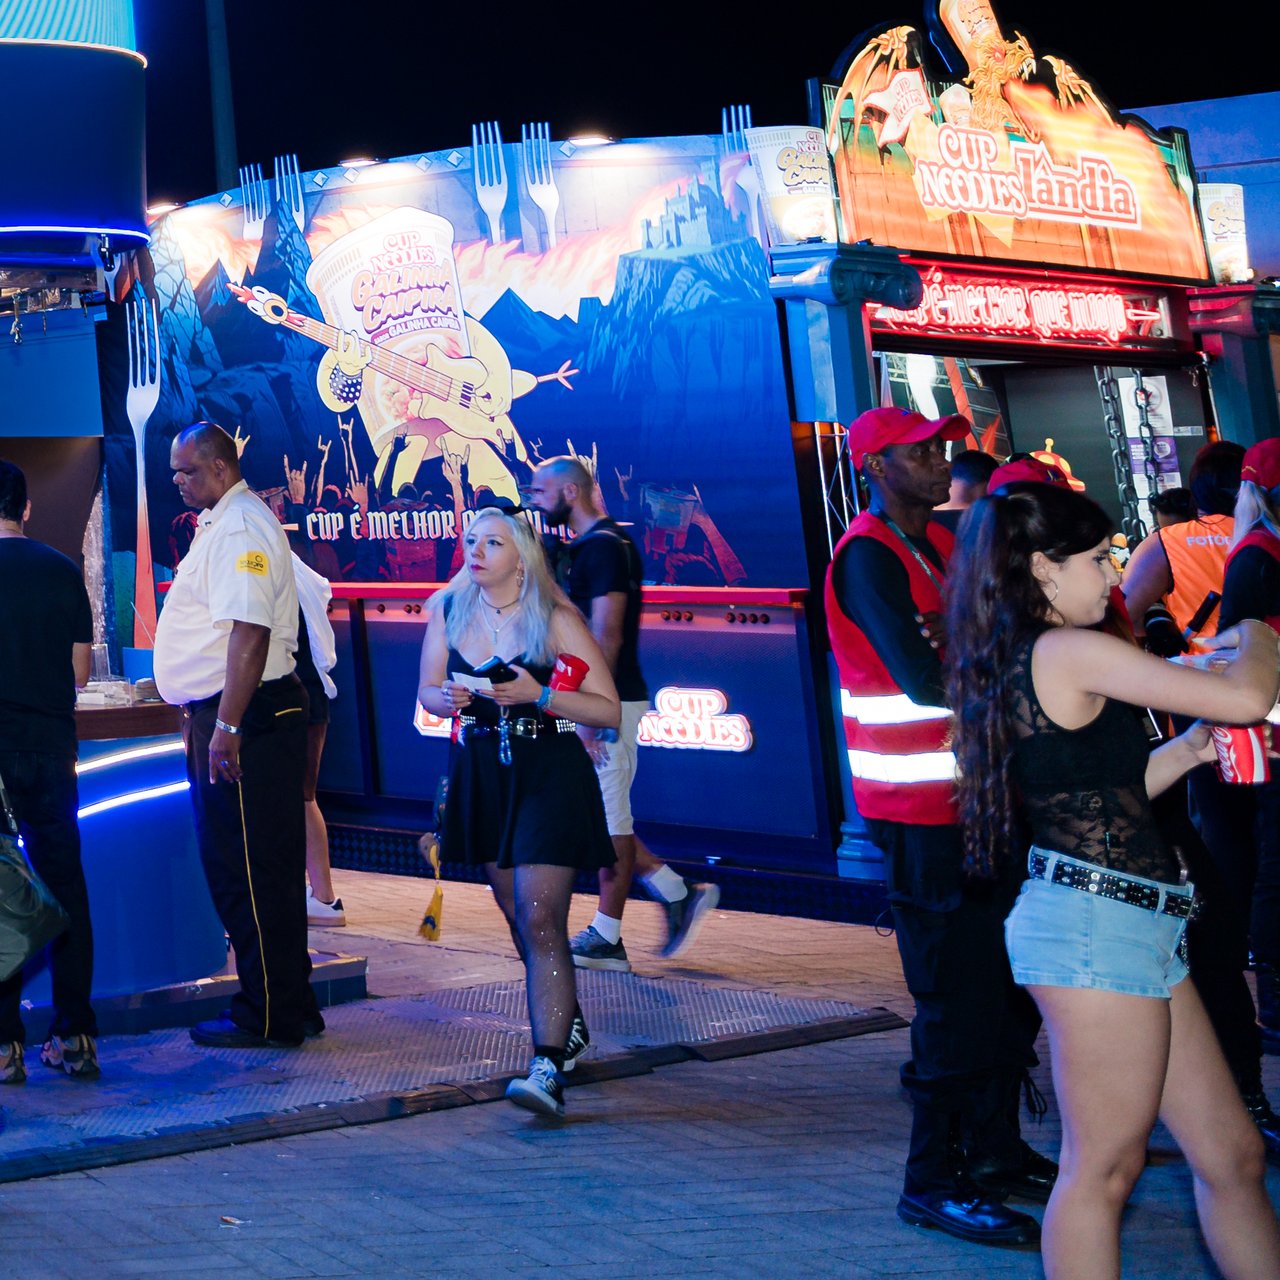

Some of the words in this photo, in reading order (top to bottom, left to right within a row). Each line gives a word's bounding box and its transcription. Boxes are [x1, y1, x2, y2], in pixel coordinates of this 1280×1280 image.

[940, 126, 996, 170] CUP
[918, 161, 1027, 217] NOODLES
[371, 246, 436, 273] NOODLES
[384, 231, 420, 252] CUP
[352, 261, 451, 310] GALINHA
[362, 285, 458, 334] CAIPIRA
[306, 510, 344, 541] CUP
[350, 504, 363, 540] É
[367, 509, 458, 541] MELHOR
[660, 691, 721, 718] CUP
[640, 713, 747, 748] NOODLES
